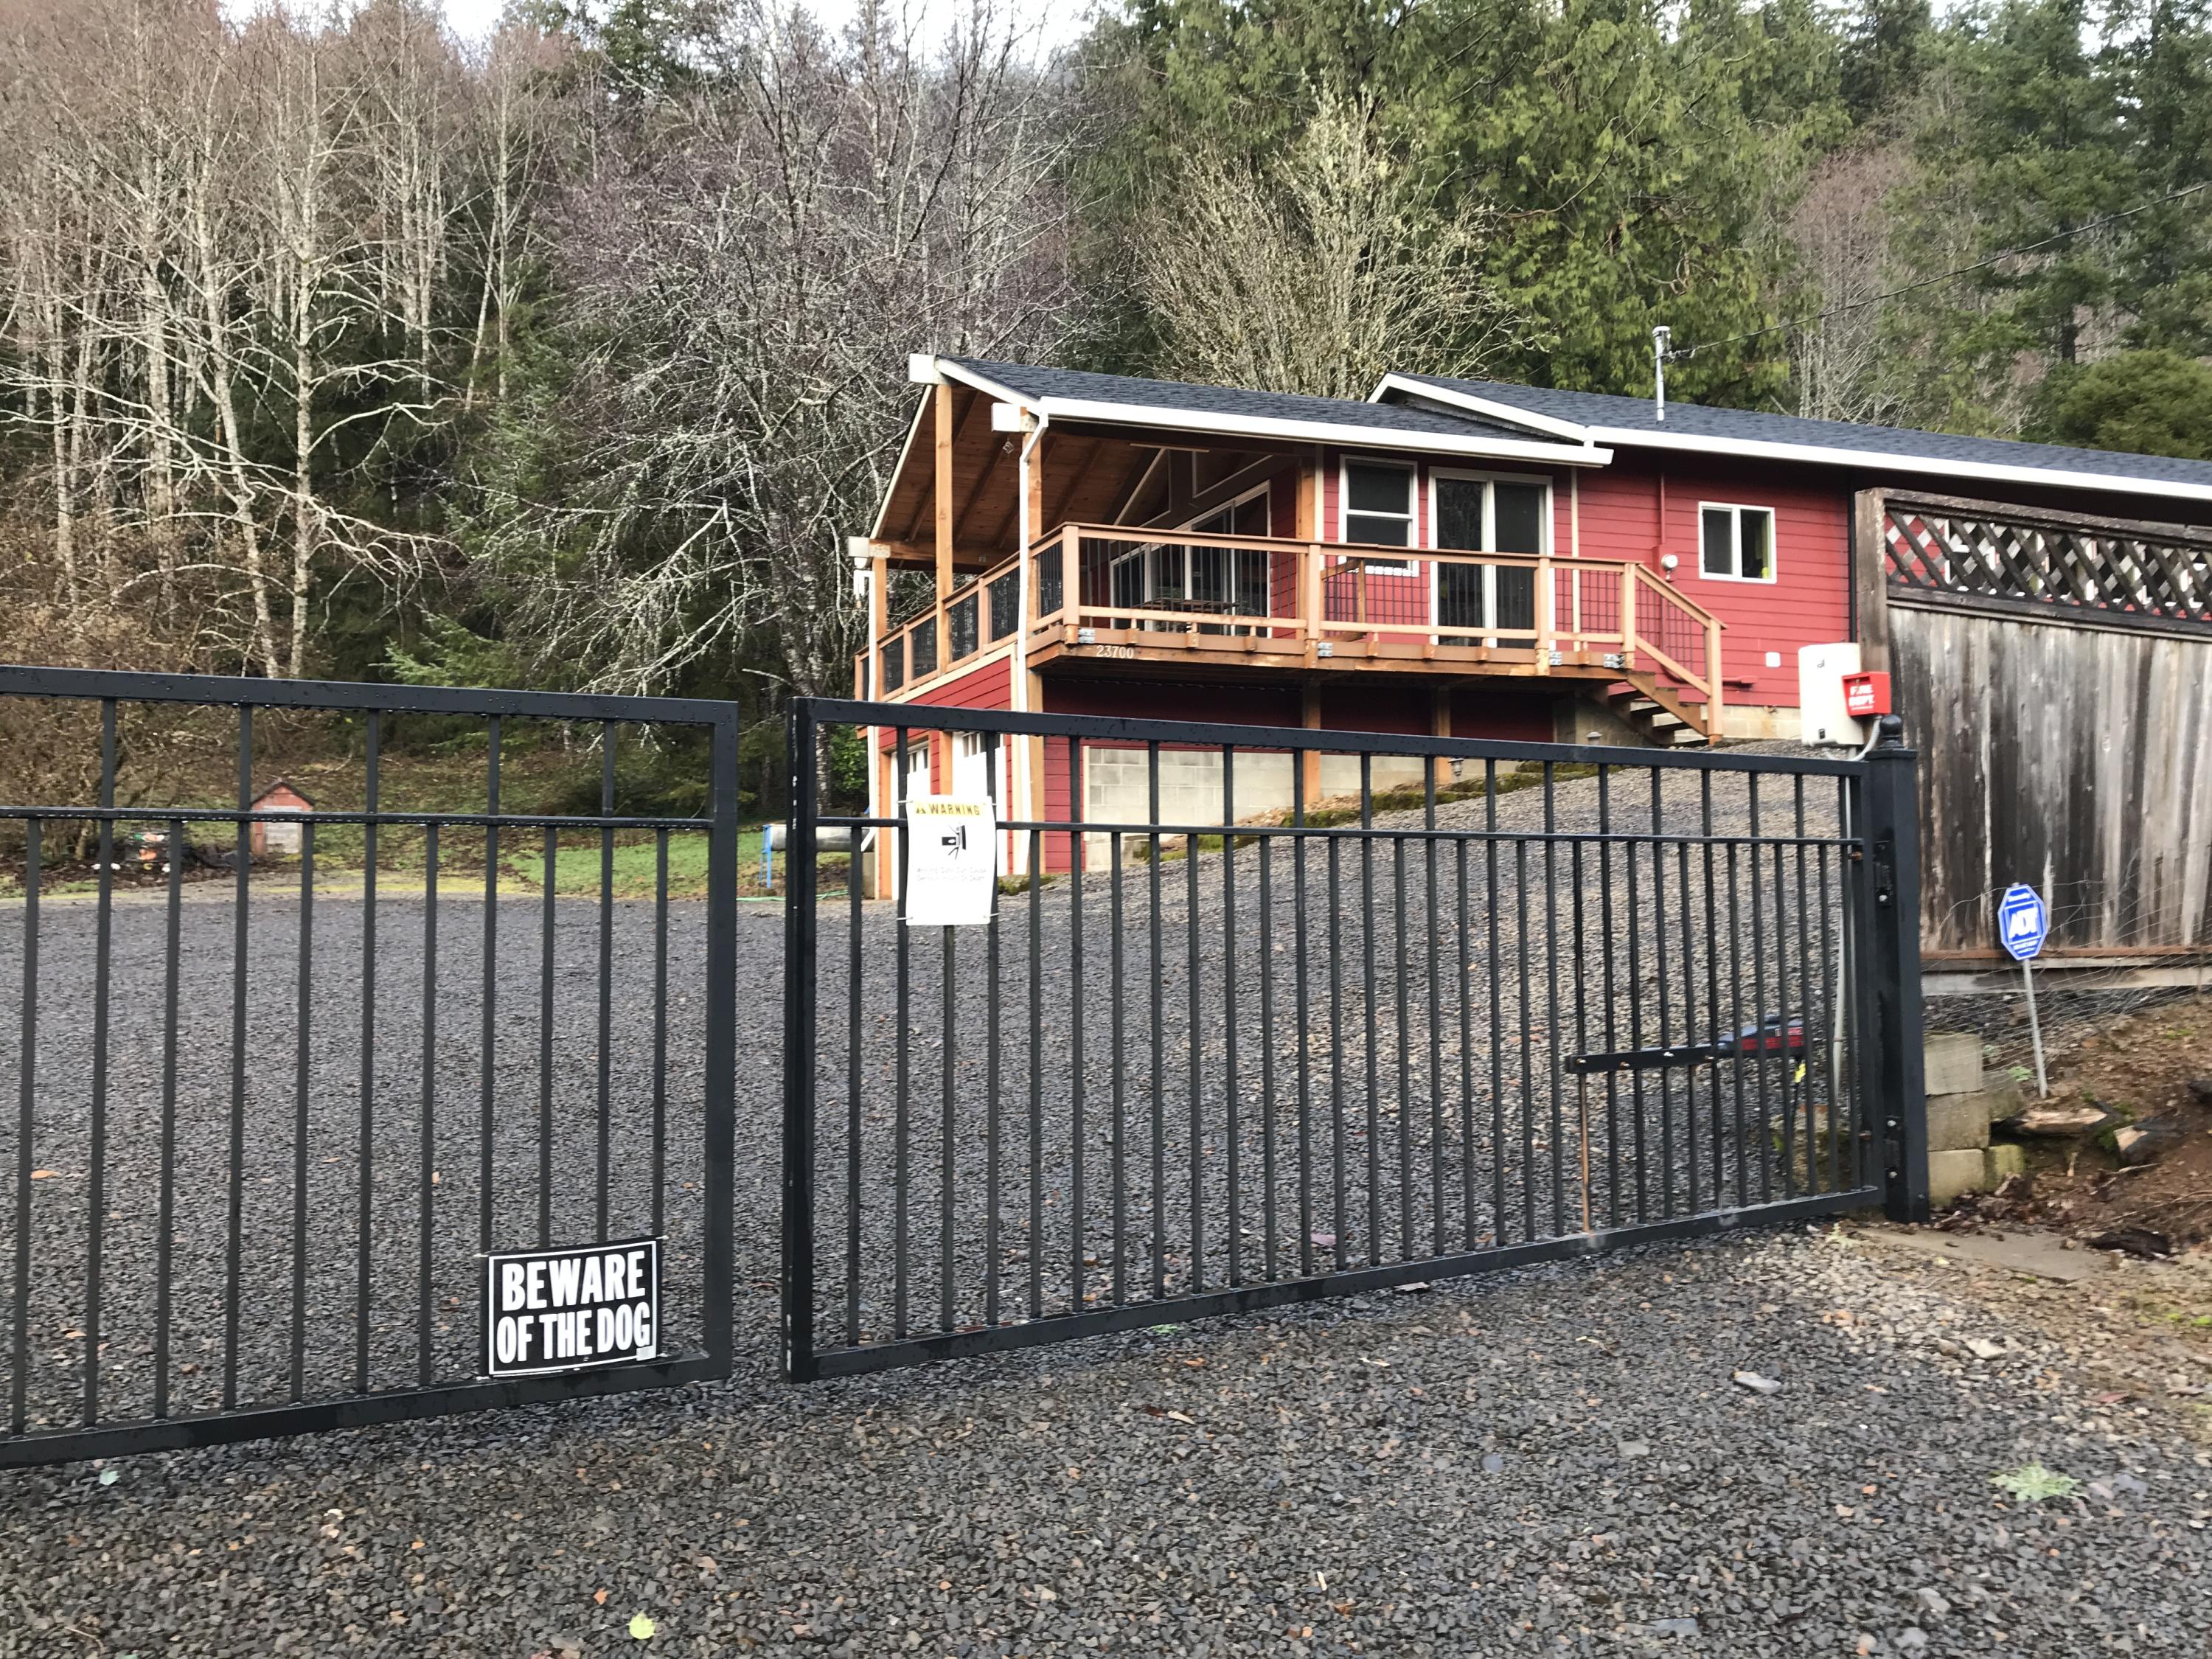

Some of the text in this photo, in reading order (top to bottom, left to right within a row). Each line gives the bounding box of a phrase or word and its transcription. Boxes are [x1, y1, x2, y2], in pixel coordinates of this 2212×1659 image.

[1096, 644, 1134, 658] 23700
[929, 802, 980, 815] WARNING
[2008, 907, 2039, 939] ADT
[502, 1251, 645, 1311] BEWARE
[497, 1301, 650, 1363] OF THE DOG
